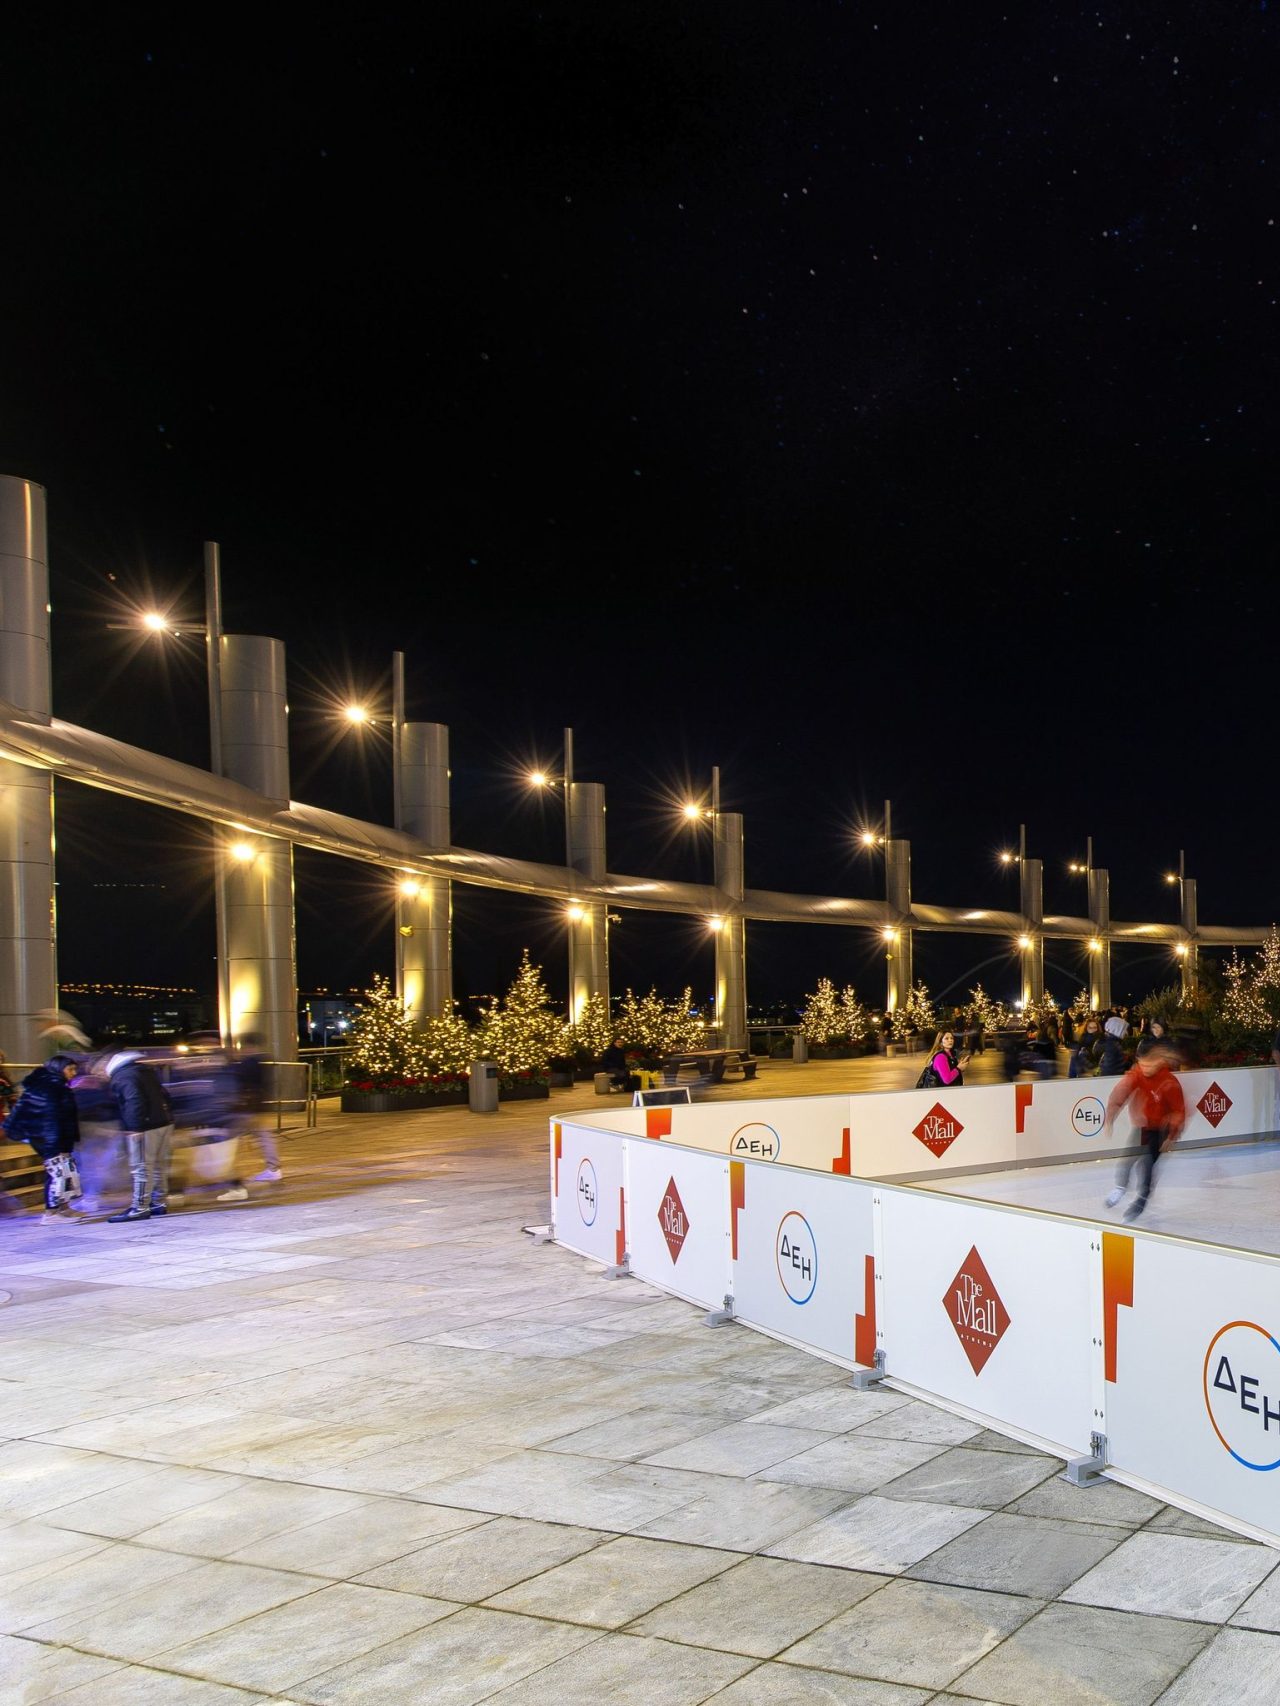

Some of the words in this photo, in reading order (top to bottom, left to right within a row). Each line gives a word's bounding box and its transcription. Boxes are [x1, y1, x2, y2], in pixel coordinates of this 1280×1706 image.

[923, 1122, 955, 1140] Mall
[1075, 1108, 1101, 1125] ΔΕΗ
[735, 1137, 772, 1156] ΔΕΗ
[663, 1206, 684, 1237] Mall
[780, 1234, 811, 1281] ΔΕΗ
[960, 1273, 983, 1302] The
[956, 1289, 997, 1336] Mall
